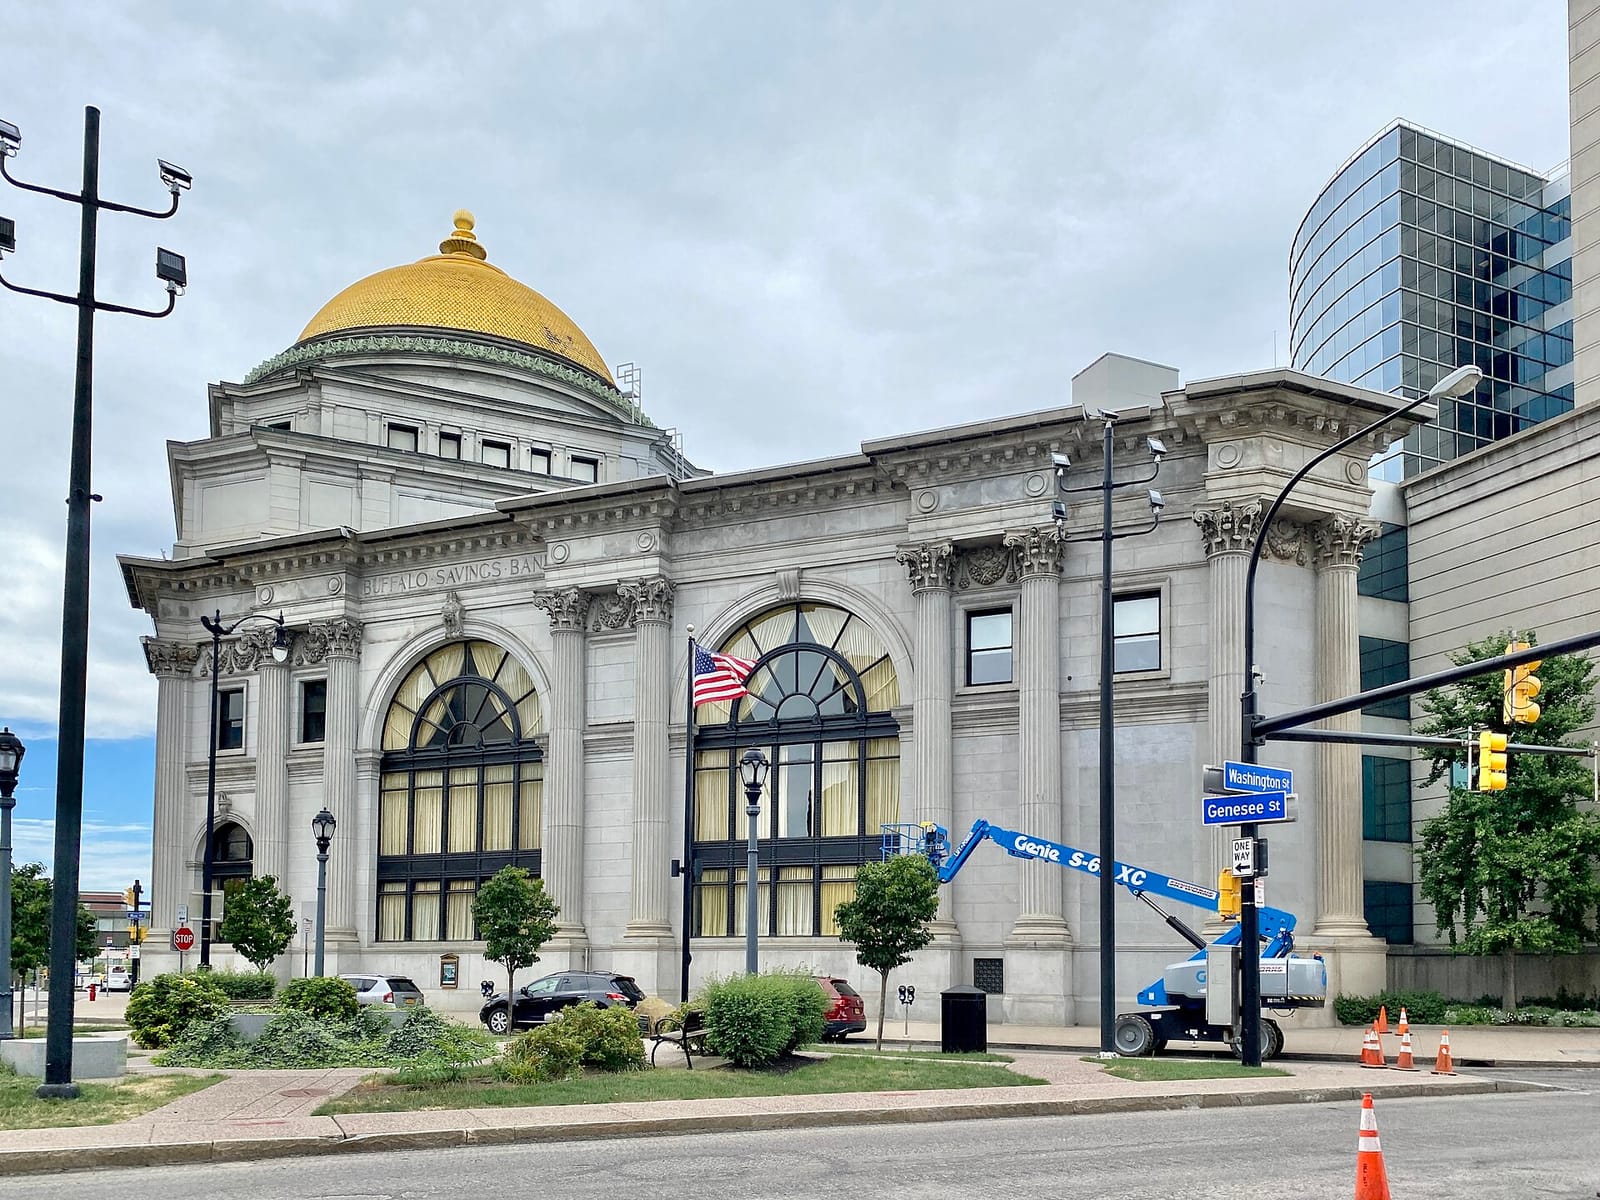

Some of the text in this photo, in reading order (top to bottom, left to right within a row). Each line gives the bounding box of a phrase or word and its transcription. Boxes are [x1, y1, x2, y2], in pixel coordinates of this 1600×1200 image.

[363, 557, 546, 595] BUFFALO SAVINGS BAN
[1228, 769, 1290, 791] Washington St
[1208, 800, 1281, 818] Genesee St
[1234, 841, 1250, 851] ONE
[1014, 835, 1147, 886] Genie S-6 XC
[1234, 852, 1250, 861] WAY
[175, 934, 193, 943] STOP
